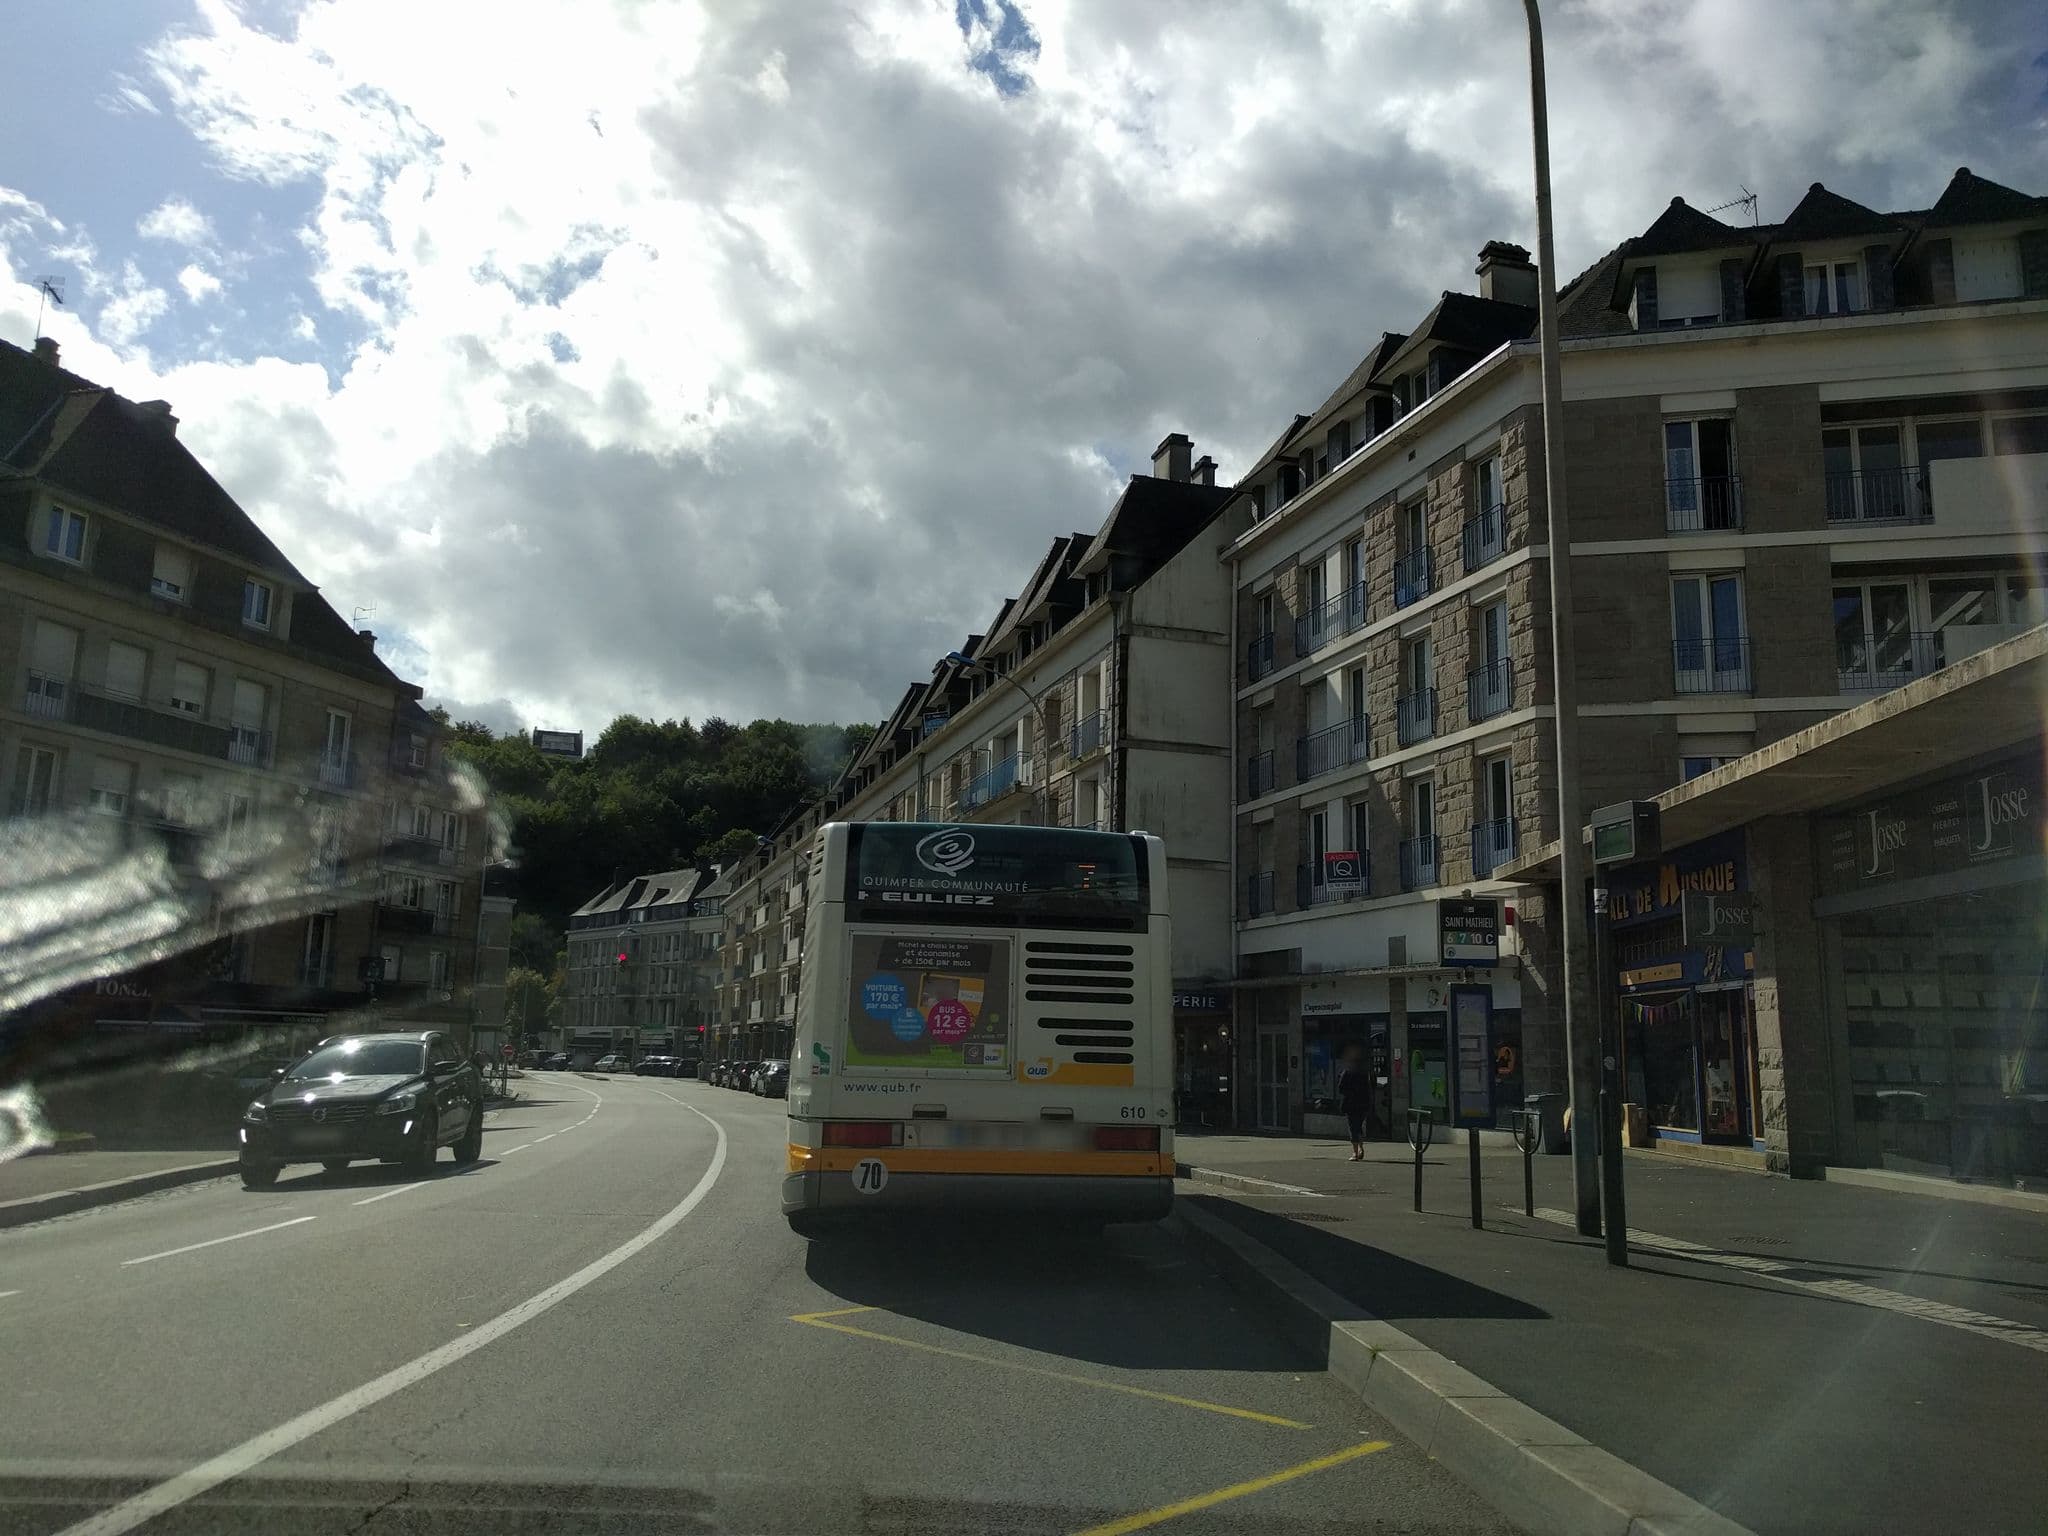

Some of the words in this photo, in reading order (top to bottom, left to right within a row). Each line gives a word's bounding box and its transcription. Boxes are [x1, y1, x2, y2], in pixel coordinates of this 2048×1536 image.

[1865, 808, 1907, 876] Josse
[863, 876, 924, 888] QUIMPER
[931, 877, 1029, 892] COMMUNAUTÉ
[1445, 916, 1465, 928] SAINT
[1465, 917, 1494, 929] MATHIEU
[1700, 895, 1751, 937] Josse
[1446, 932, 1455, 944] 6
[1459, 933, 1467, 944] 7
[1471, 933, 1482, 945] 10
[1485, 933, 1494, 945] C
[902, 957, 913, 965] de
[870, 992, 889, 1002] 170
[939, 1005, 957, 1014] BUS
[934, 1014, 952, 1027] 12
[954, 1015, 969, 1028] €
[1027, 1066, 1049, 1077] QUB
[843, 1081, 922, 1095] www.qub.fr
[1120, 1105, 1146, 1119] 610
[859, 1162, 882, 1190] 70
